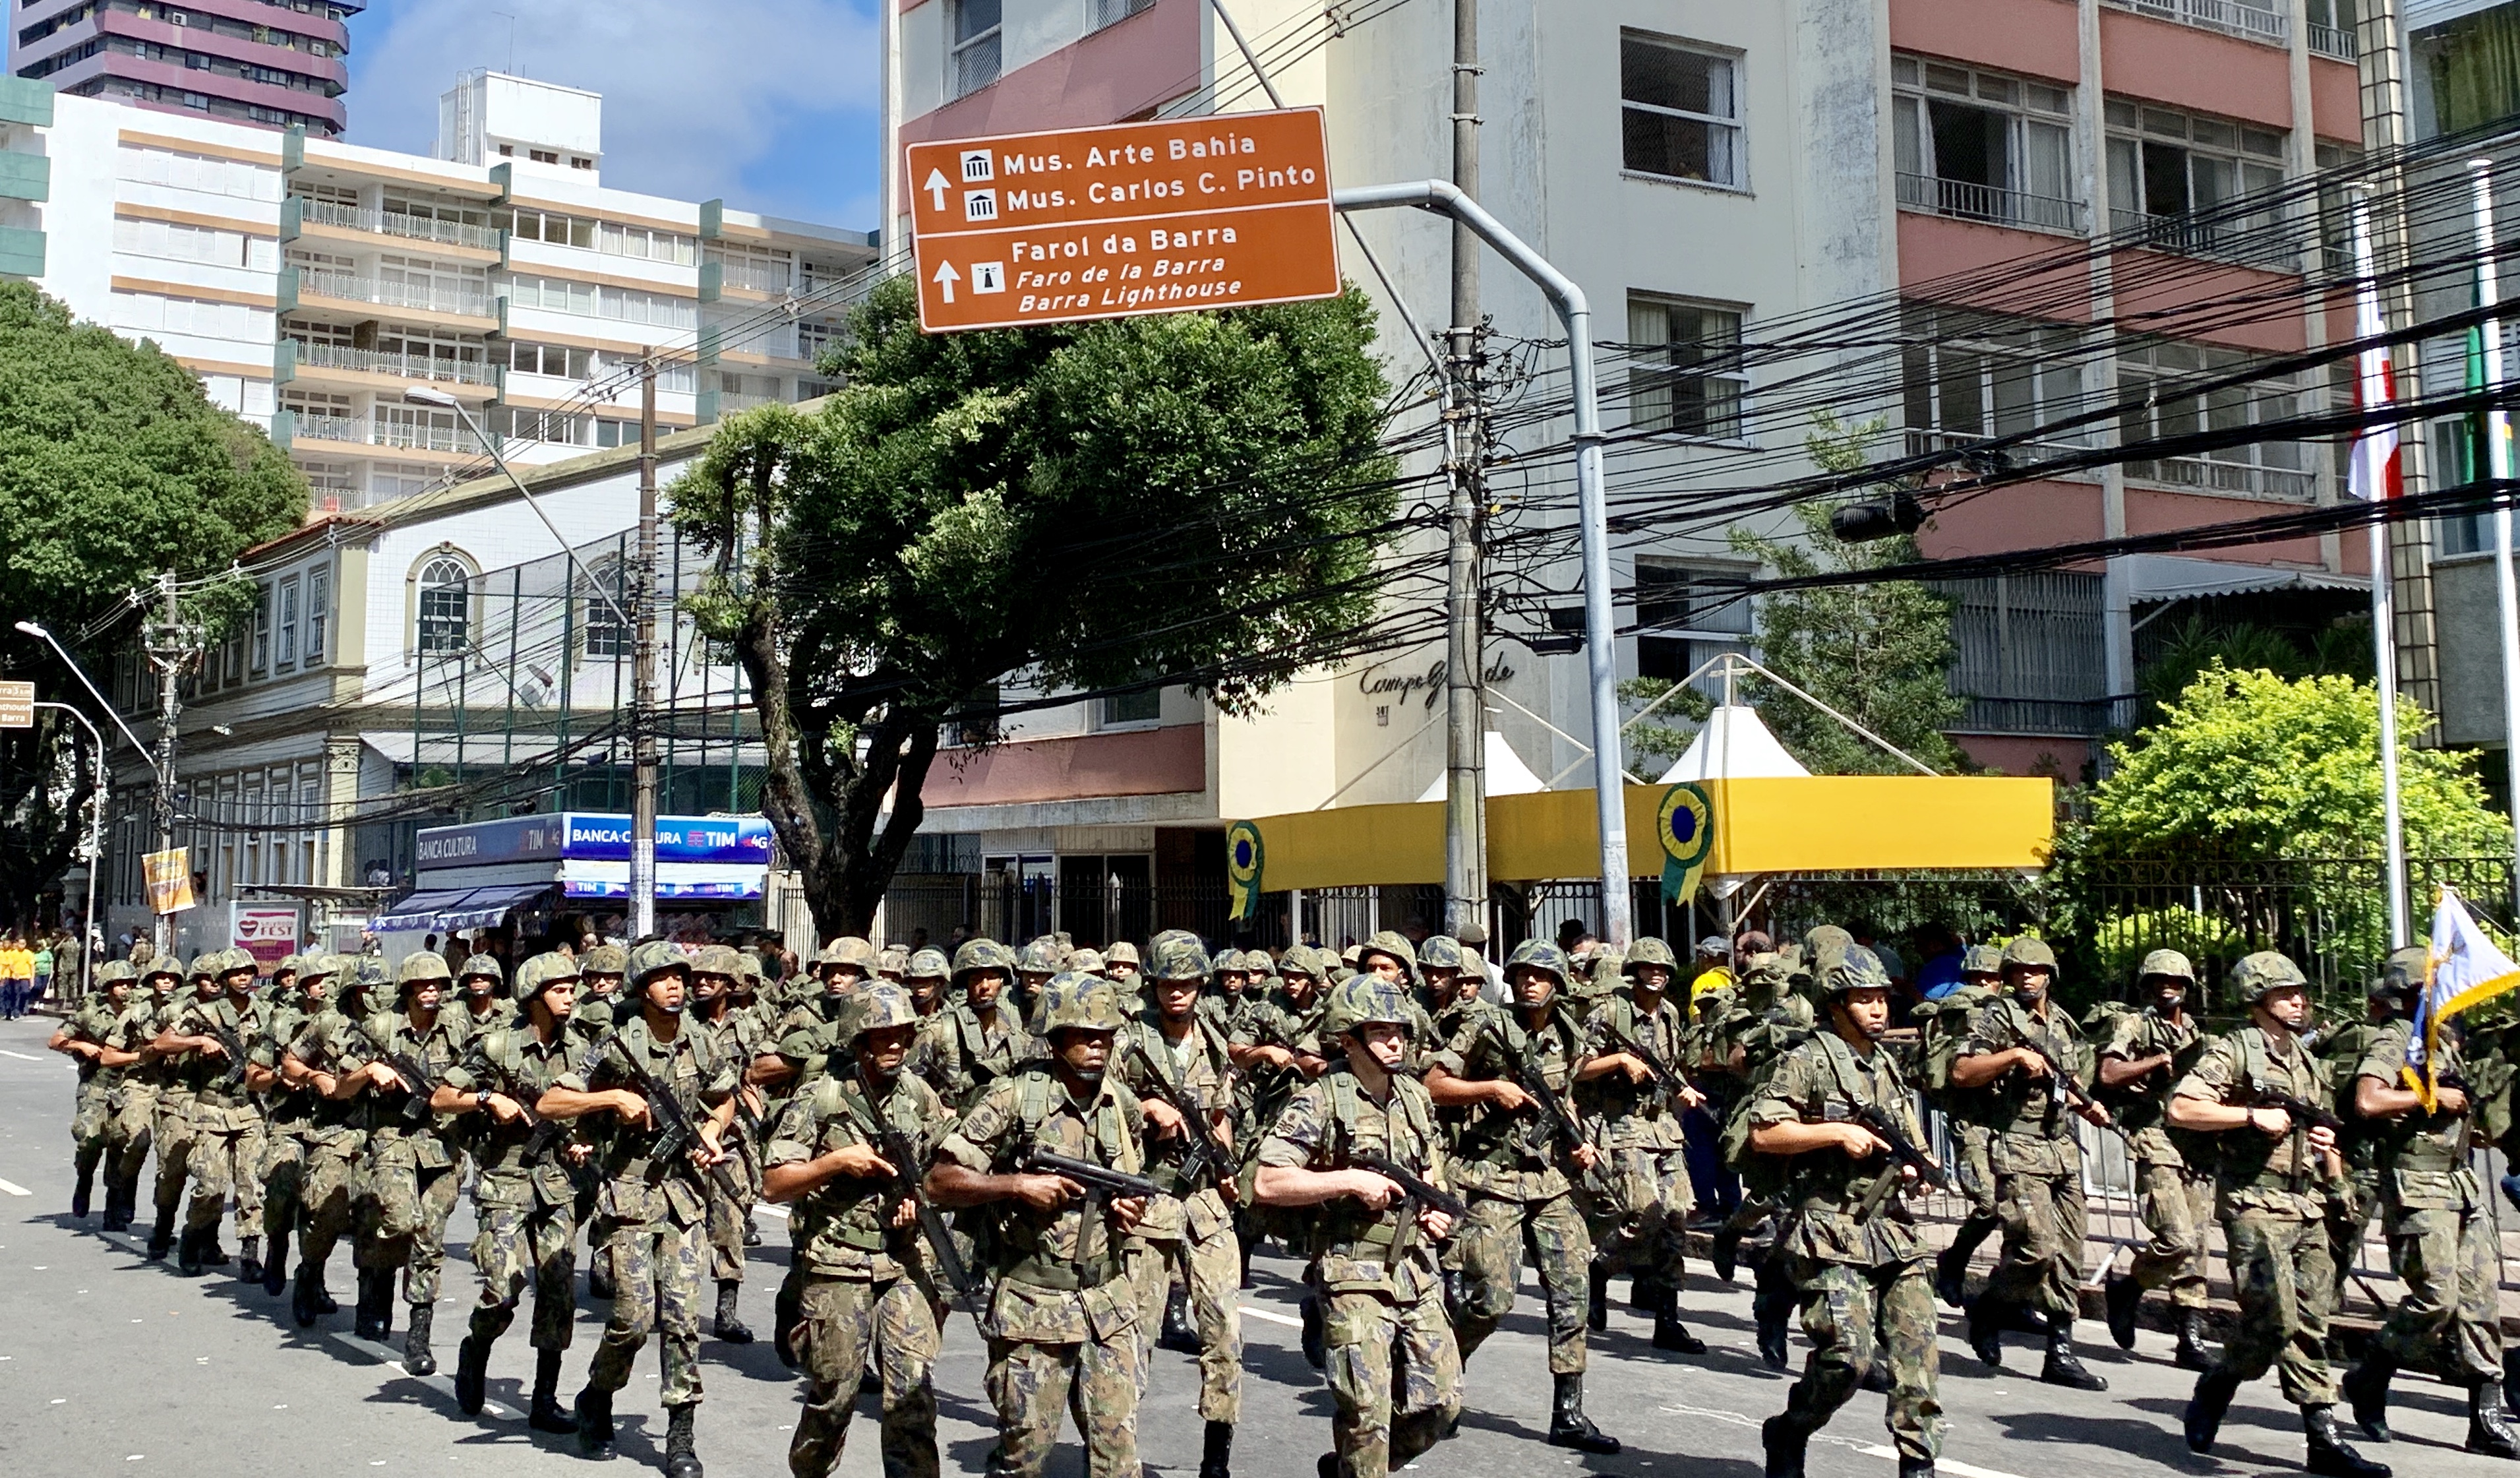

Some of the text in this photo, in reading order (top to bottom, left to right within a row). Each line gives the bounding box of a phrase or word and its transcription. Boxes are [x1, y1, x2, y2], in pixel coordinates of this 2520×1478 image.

[1004, 133, 1255, 175] Mus. Arte Bahia
[1007, 166, 1315, 210] Mus. Carlos C. Pinto
[1013, 228, 1236, 262] Farol da Barra
[1017, 259, 1224, 288] Faro de la Barra
[1019, 280, 1242, 312] Barra Lighthouse
[1360, 651, 1515, 709] Campo Gde
[2, 714, 25, 722] Barra
[418, 839, 442, 860] BANCA
[443, 836, 477, 858] CULTURA
[529, 828, 544, 850] TIM
[572, 829, 618, 843] BANCA
[706, 831, 736, 847] TIM
[750, 834, 768, 849] 4G
[578, 882, 597, 892] TIM
[716, 884, 735, 892] TIM
[260, 926, 292, 936] FEST
